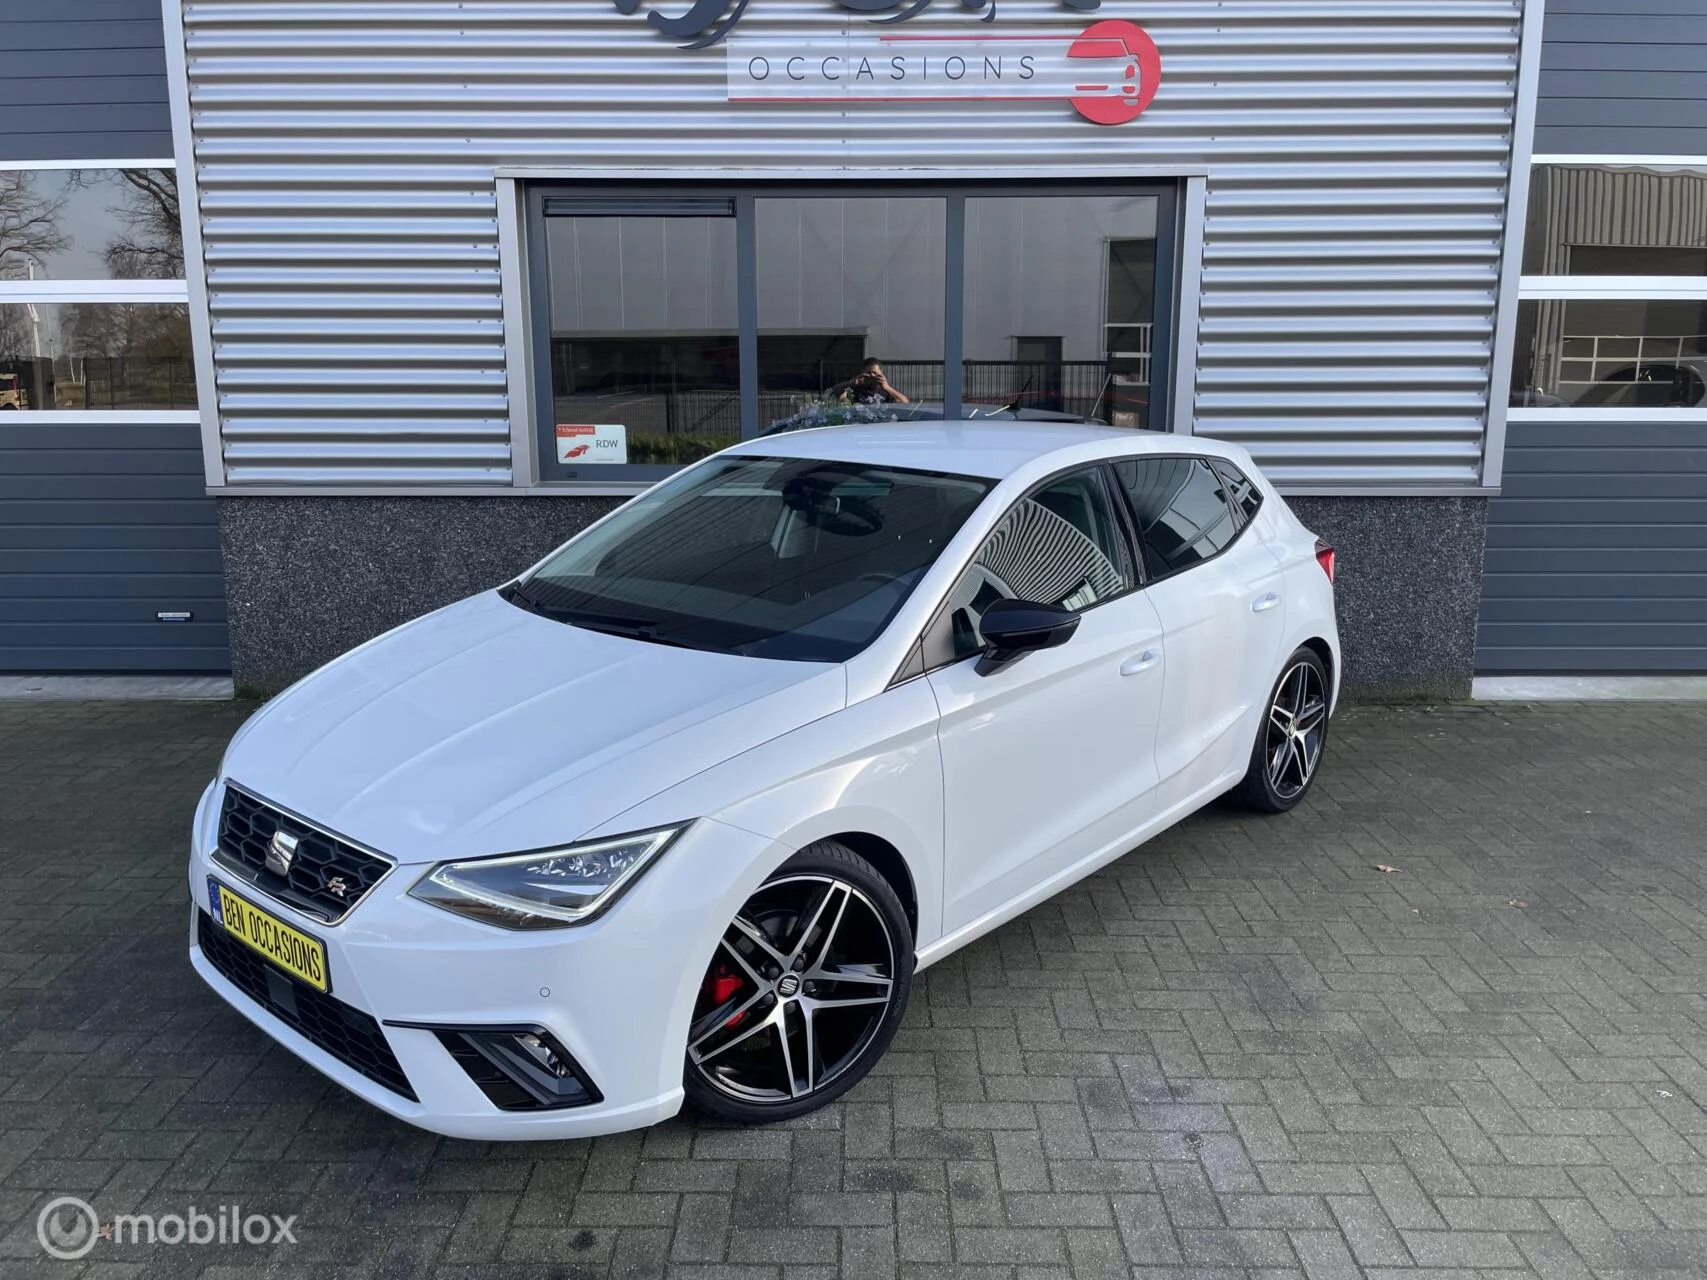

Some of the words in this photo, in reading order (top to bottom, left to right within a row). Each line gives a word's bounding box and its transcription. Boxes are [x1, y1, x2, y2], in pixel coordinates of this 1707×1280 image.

[748, 56, 1035, 81] OCCASIONS
[596, 440, 618, 448] RDW
[223, 894, 246, 937] BEN
[249, 911, 321, 982] OCCASIONS
